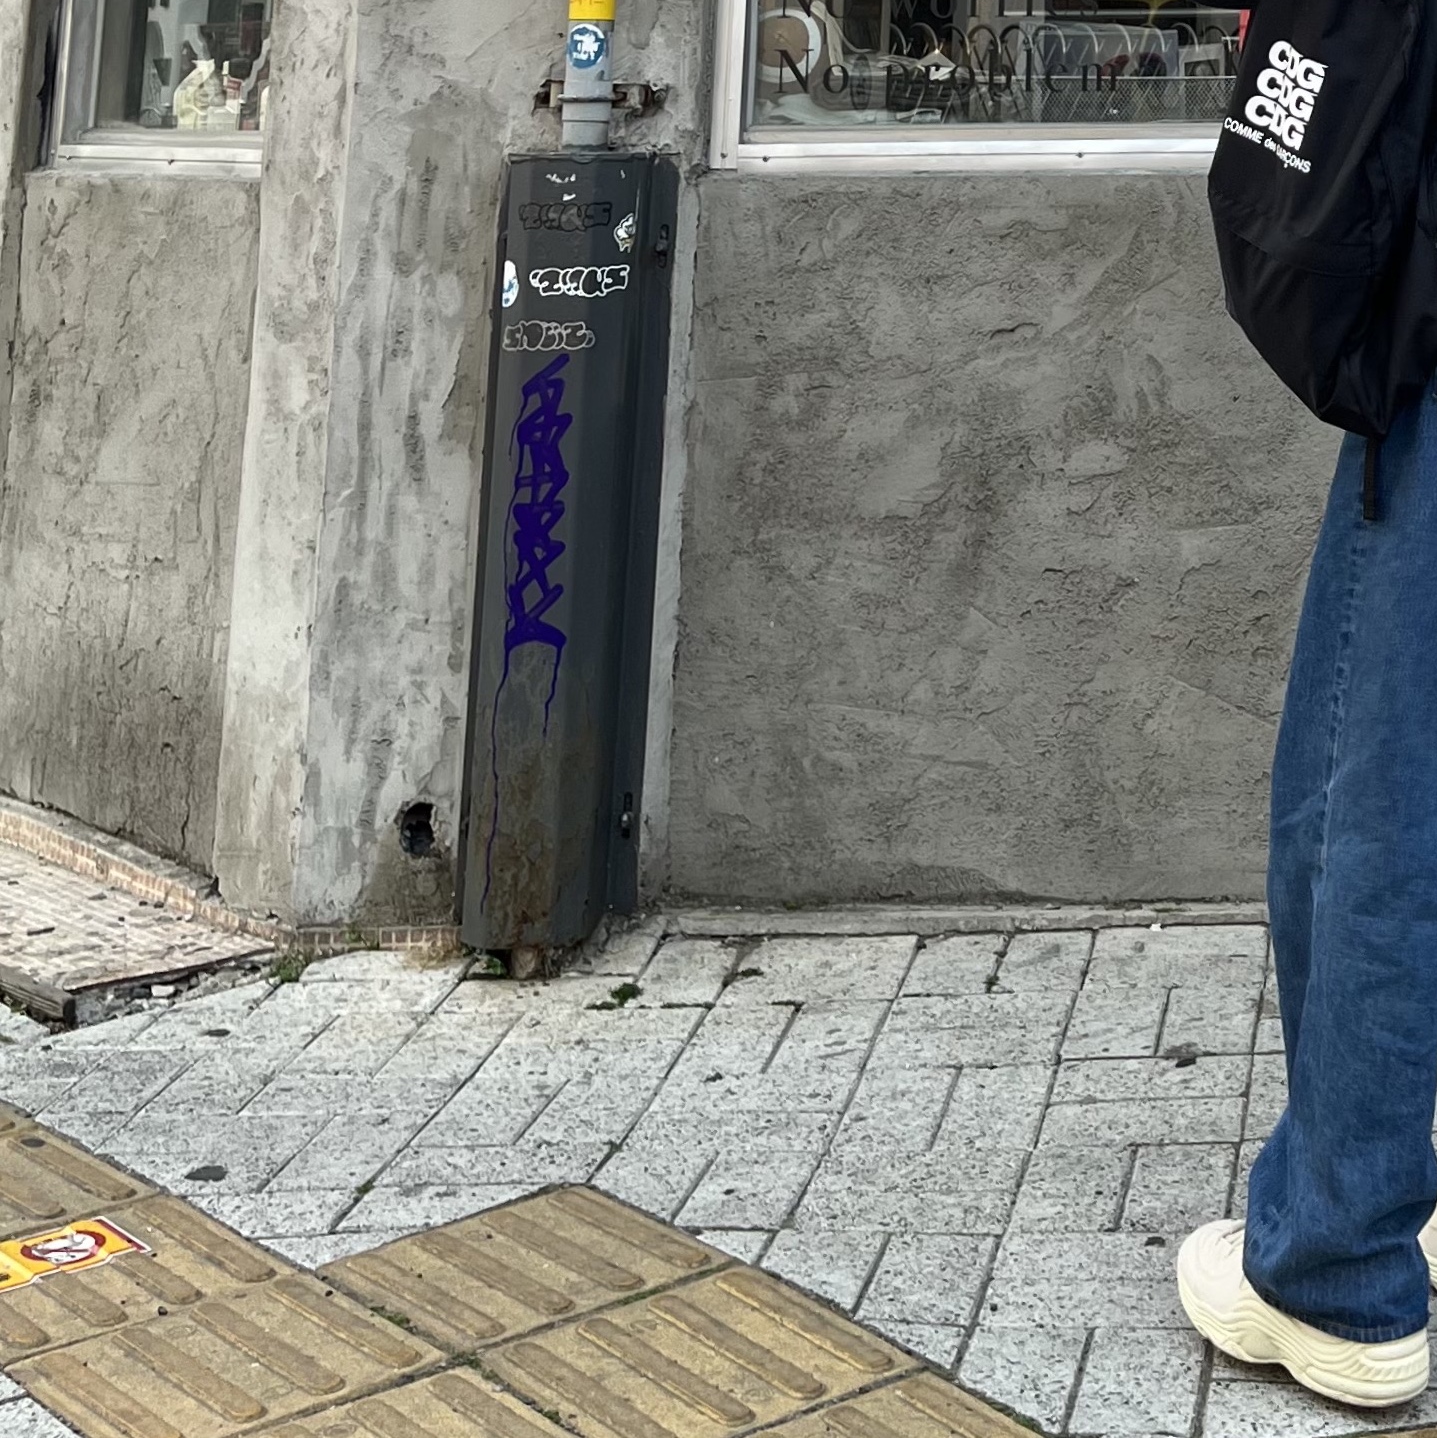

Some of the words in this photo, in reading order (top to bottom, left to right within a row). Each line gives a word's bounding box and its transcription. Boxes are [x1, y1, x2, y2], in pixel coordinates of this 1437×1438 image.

[777, 48, 850, 94] No
[886, 48, 1121, 108] problem
[1268, 40, 1329, 94] CDG
[1256, 68, 1318, 122] CDG
[1224, 117, 1265, 144] COMME
[1244, 95, 1309, 151] CDG
